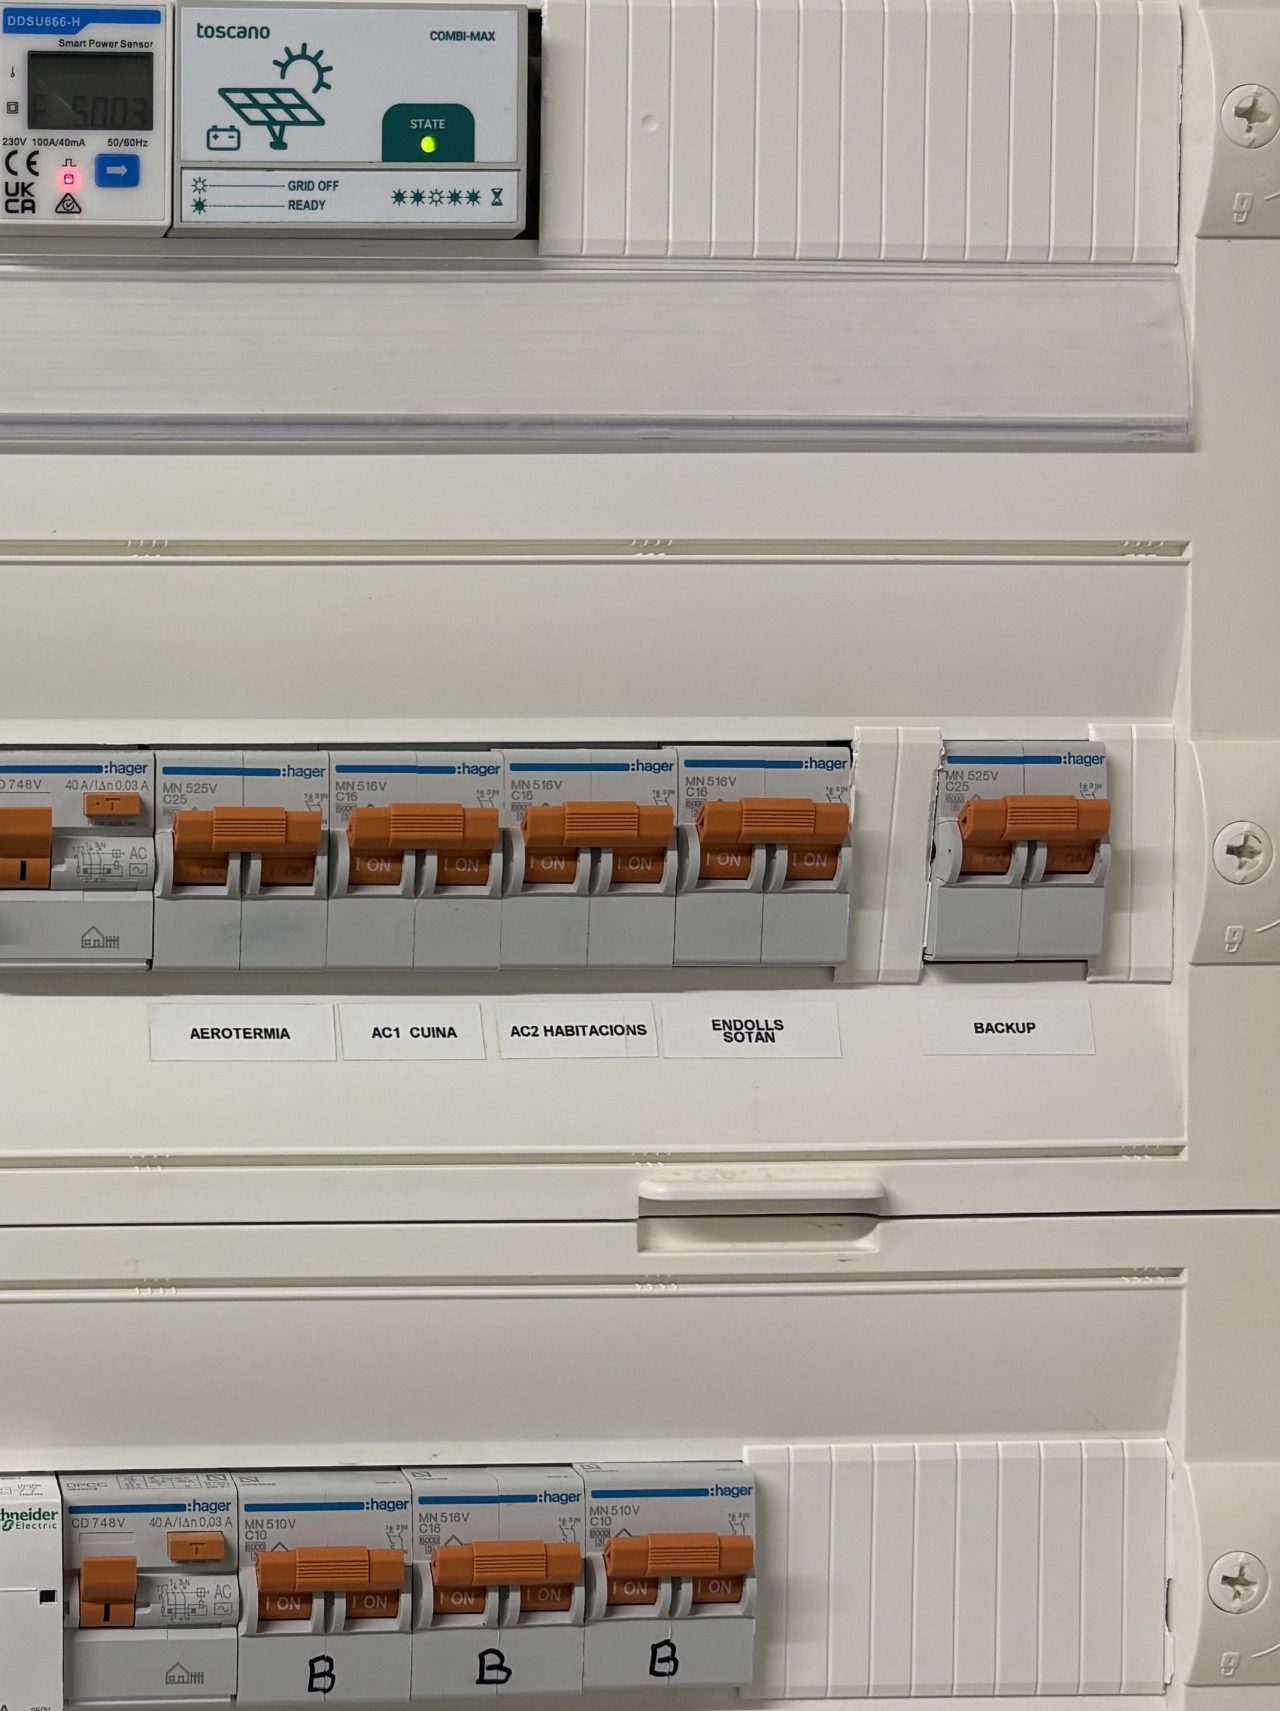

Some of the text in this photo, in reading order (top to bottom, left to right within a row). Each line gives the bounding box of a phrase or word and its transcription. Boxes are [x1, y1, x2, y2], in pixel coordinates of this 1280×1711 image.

[8, 16, 80, 27] DDSU666-H
[196, 23, 270, 40] toscano
[430, 30, 496, 42] COMBI-MAX
[58, 39, 153, 48] Smart Power Sensor
[410, 119, 446, 130] STATE
[3, 138, 148, 148] 230V 100A/40mA 50/60Hz
[5, 150, 39, 176] CE
[5, 182, 35, 198] UK
[288, 180, 339, 192] GRID OFF
[5, 200, 36, 214] CA
[288, 200, 326, 211] READY
[686, 776, 736, 786] MN 516V
[946, 771, 998, 781] MN 525V
[10, 780, 42, 790] 748V
[65, 780, 80, 790] 40
[140, 780, 149, 790] A
[163, 784, 218, 794] MN 525V
[335, 781, 387, 791] MN 516V
[946, 782, 969, 792] C25
[336, 792, 358, 802] C16
[686, 787, 708, 797] C16
[163, 794, 188, 804] C25
[130, 847, 147, 860] AC
[367, 858, 390, 872] ON
[716, 854, 741, 868] ON
[712, 1019, 784, 1031] ENDOLLS
[974, 1022, 1036, 1034] BACKUP
[190, 1028, 290, 1040] AEROTERMIA
[372, 1026, 458, 1038] AC1 CUINA
[510, 1024, 646, 1038] AC2 HABITACIONS
[723, 1032, 775, 1043] SOTAN
[590, 1506, 640, 1516] MN 510V
[72, 1517, 125, 1528] CD 748V
[150, 1516, 164, 1528] 40
[224, 1516, 232, 1528] A
[419, 1512, 470, 1522] MN 516V
[590, 1517, 612, 1526] C10
[16, 1522, 56, 1530] Electric
[245, 1519, 296, 1530] MN 510V
[420, 1524, 440, 1533] C16
[245, 1530, 267, 1540] C10
[624, 1582, 647, 1596] ON
[649, 1639, 678, 1676] B
[476, 1648, 512, 1684] B
[308, 1654, 336, 1693] B
